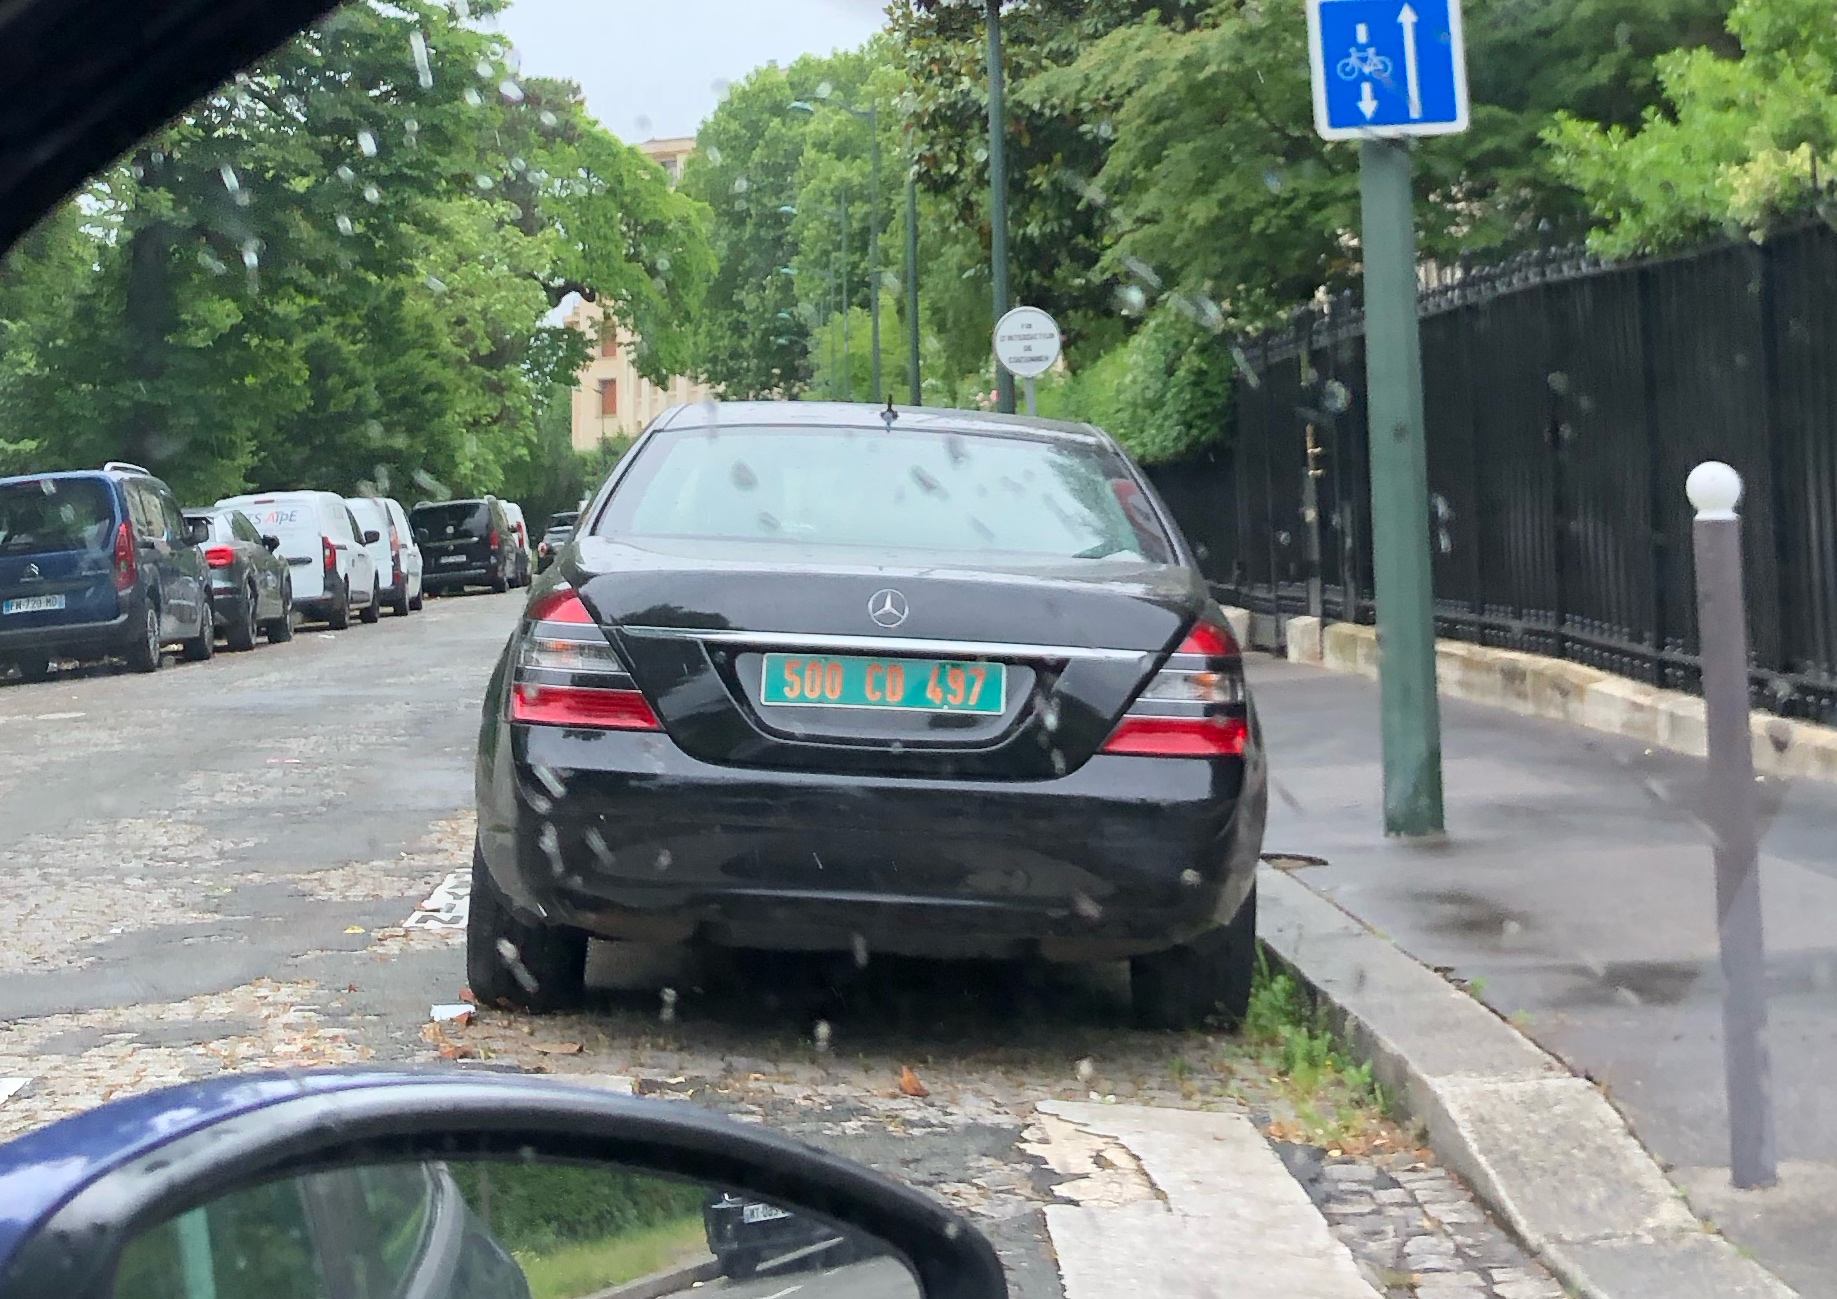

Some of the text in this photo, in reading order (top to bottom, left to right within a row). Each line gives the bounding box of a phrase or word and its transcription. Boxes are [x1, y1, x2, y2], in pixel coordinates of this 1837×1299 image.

[783, 660, 986, 706] 500 CD 497
